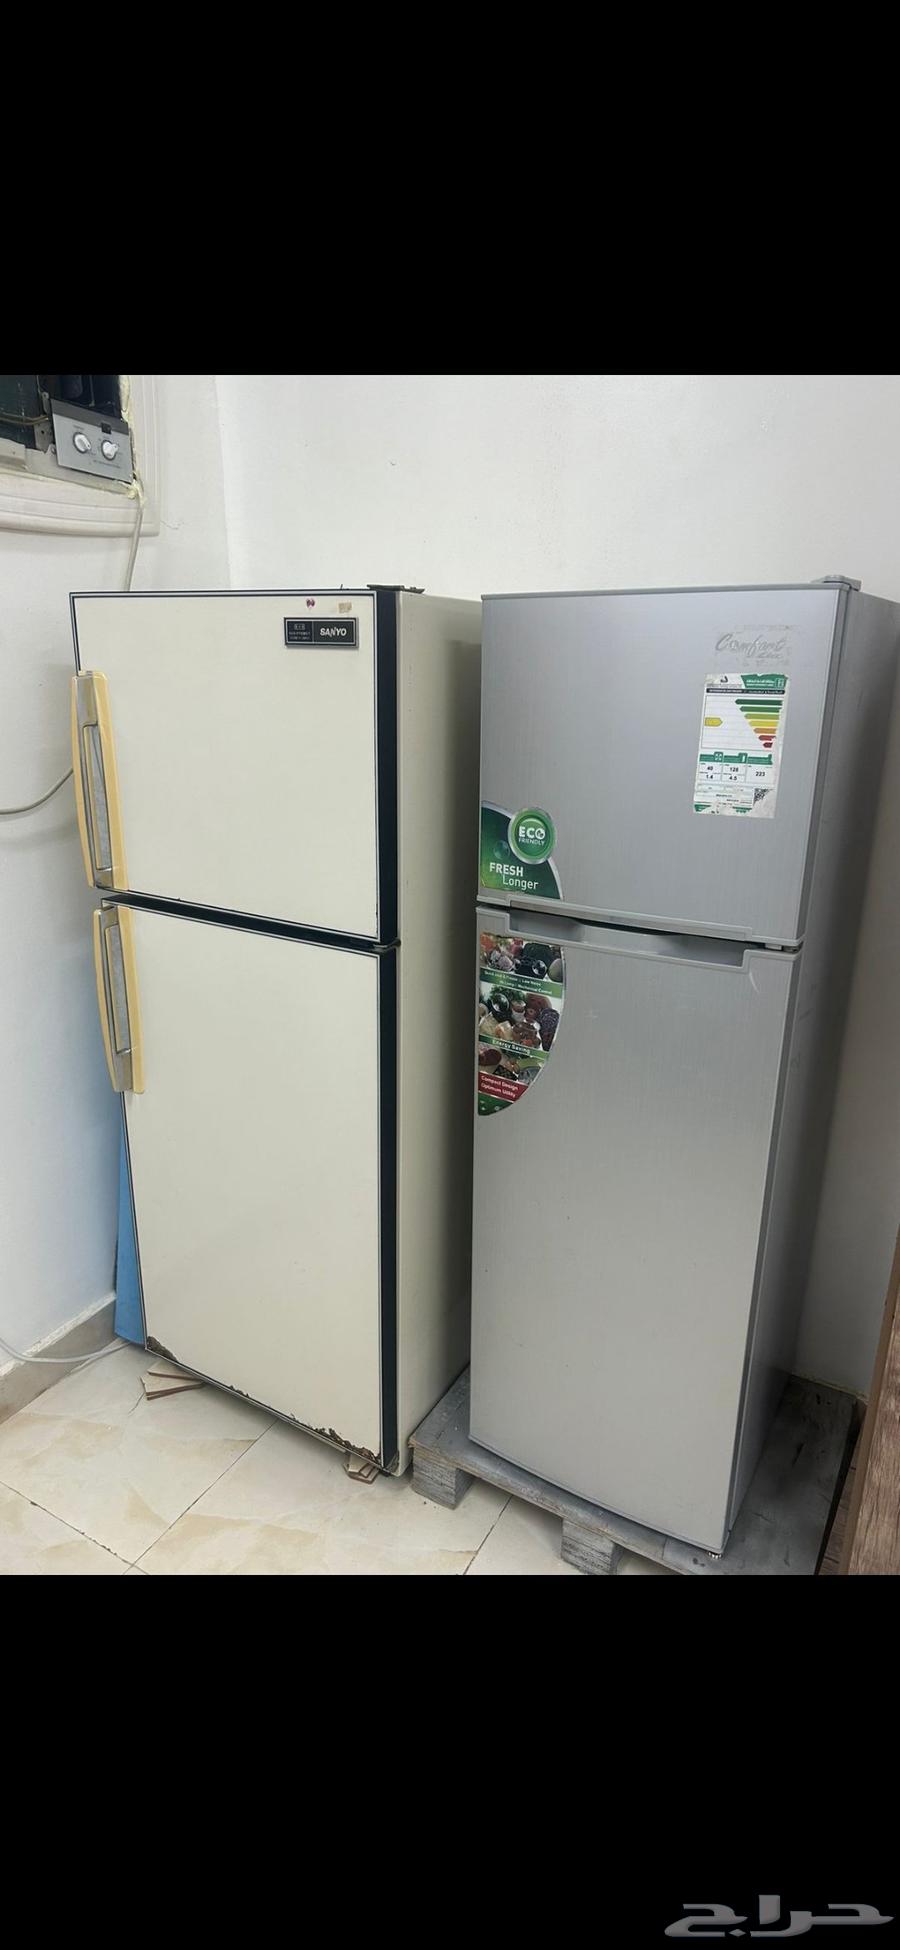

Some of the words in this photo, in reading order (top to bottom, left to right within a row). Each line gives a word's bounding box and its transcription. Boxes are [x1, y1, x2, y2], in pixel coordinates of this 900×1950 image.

[320, 626, 347, 638] SANYO
[518, 826, 546, 840] ECO
[518, 837, 545, 847] FRIENDLY
[489, 862, 524, 877] FRESH
[502, 874, 539, 891] Longer
[492, 1039, 511, 1049] Energy
[512, 1044, 531, 1055] Saving
[481, 1075, 501, 1085] Compact
[501, 1081, 519, 1091] Design
[481, 1083, 502, 1093] Optimum
[502, 1089, 516, 1098] Utility
